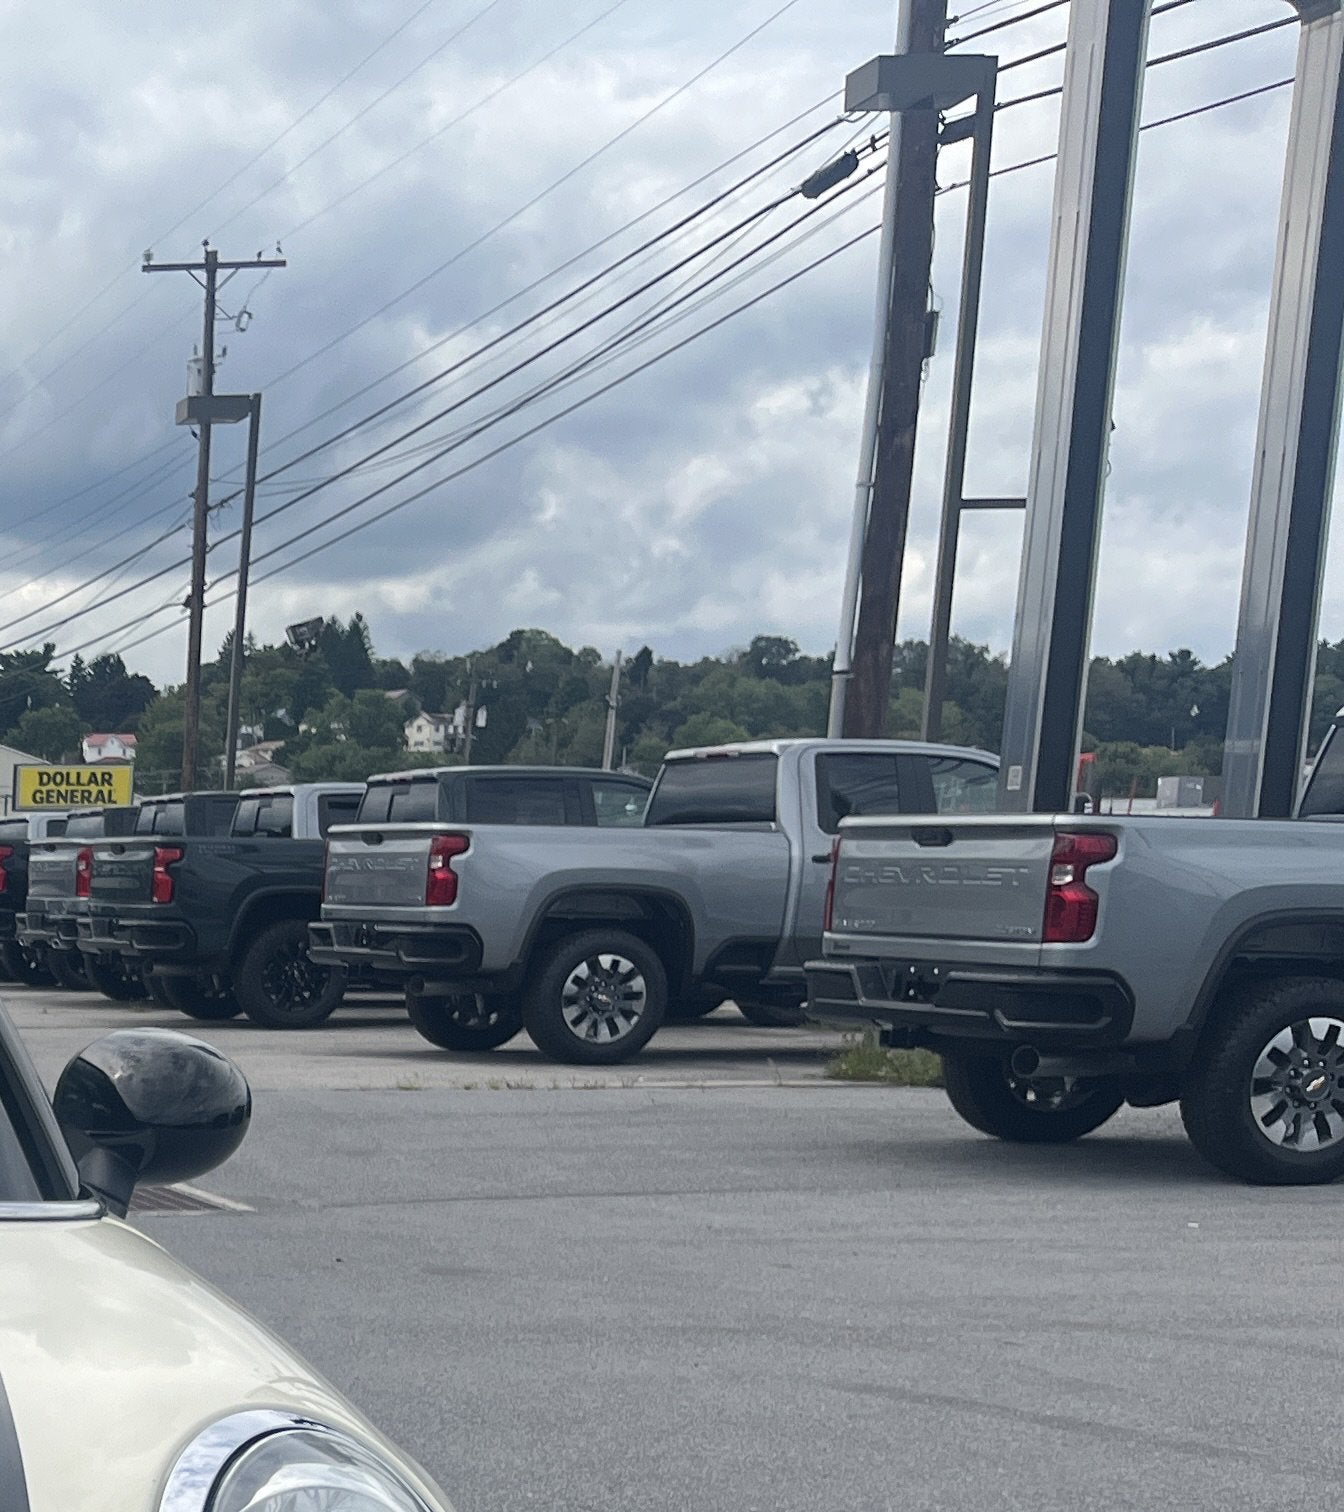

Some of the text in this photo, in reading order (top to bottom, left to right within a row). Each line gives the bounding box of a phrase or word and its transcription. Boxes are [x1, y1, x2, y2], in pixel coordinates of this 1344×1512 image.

[38, 771, 113, 787] DOLLAR
[32, 789, 117, 804] GENERAL
[844, 866, 1029, 886] CHEVROLET
